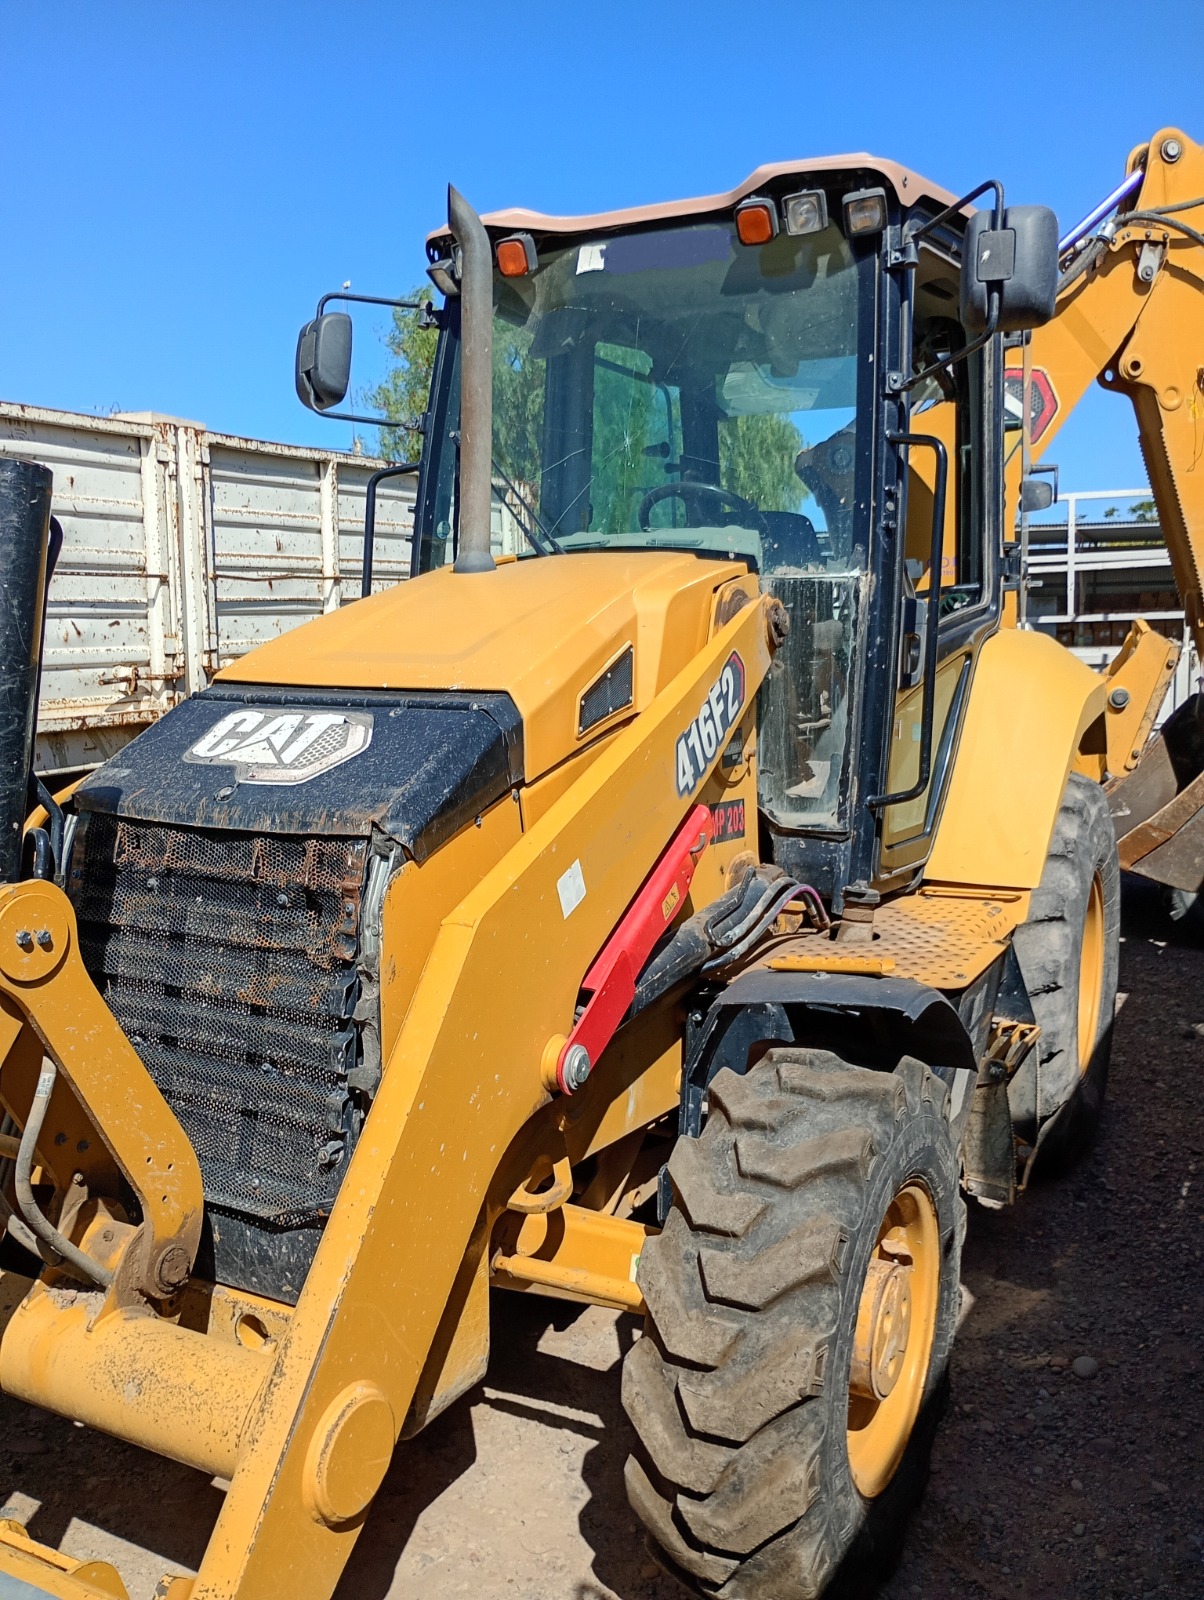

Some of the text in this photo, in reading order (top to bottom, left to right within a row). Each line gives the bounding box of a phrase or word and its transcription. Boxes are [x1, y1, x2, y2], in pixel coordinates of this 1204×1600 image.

[191, 711, 347, 764] CAT
[676, 665, 740, 793] 416F2
[727, 804, 744, 834] 203
